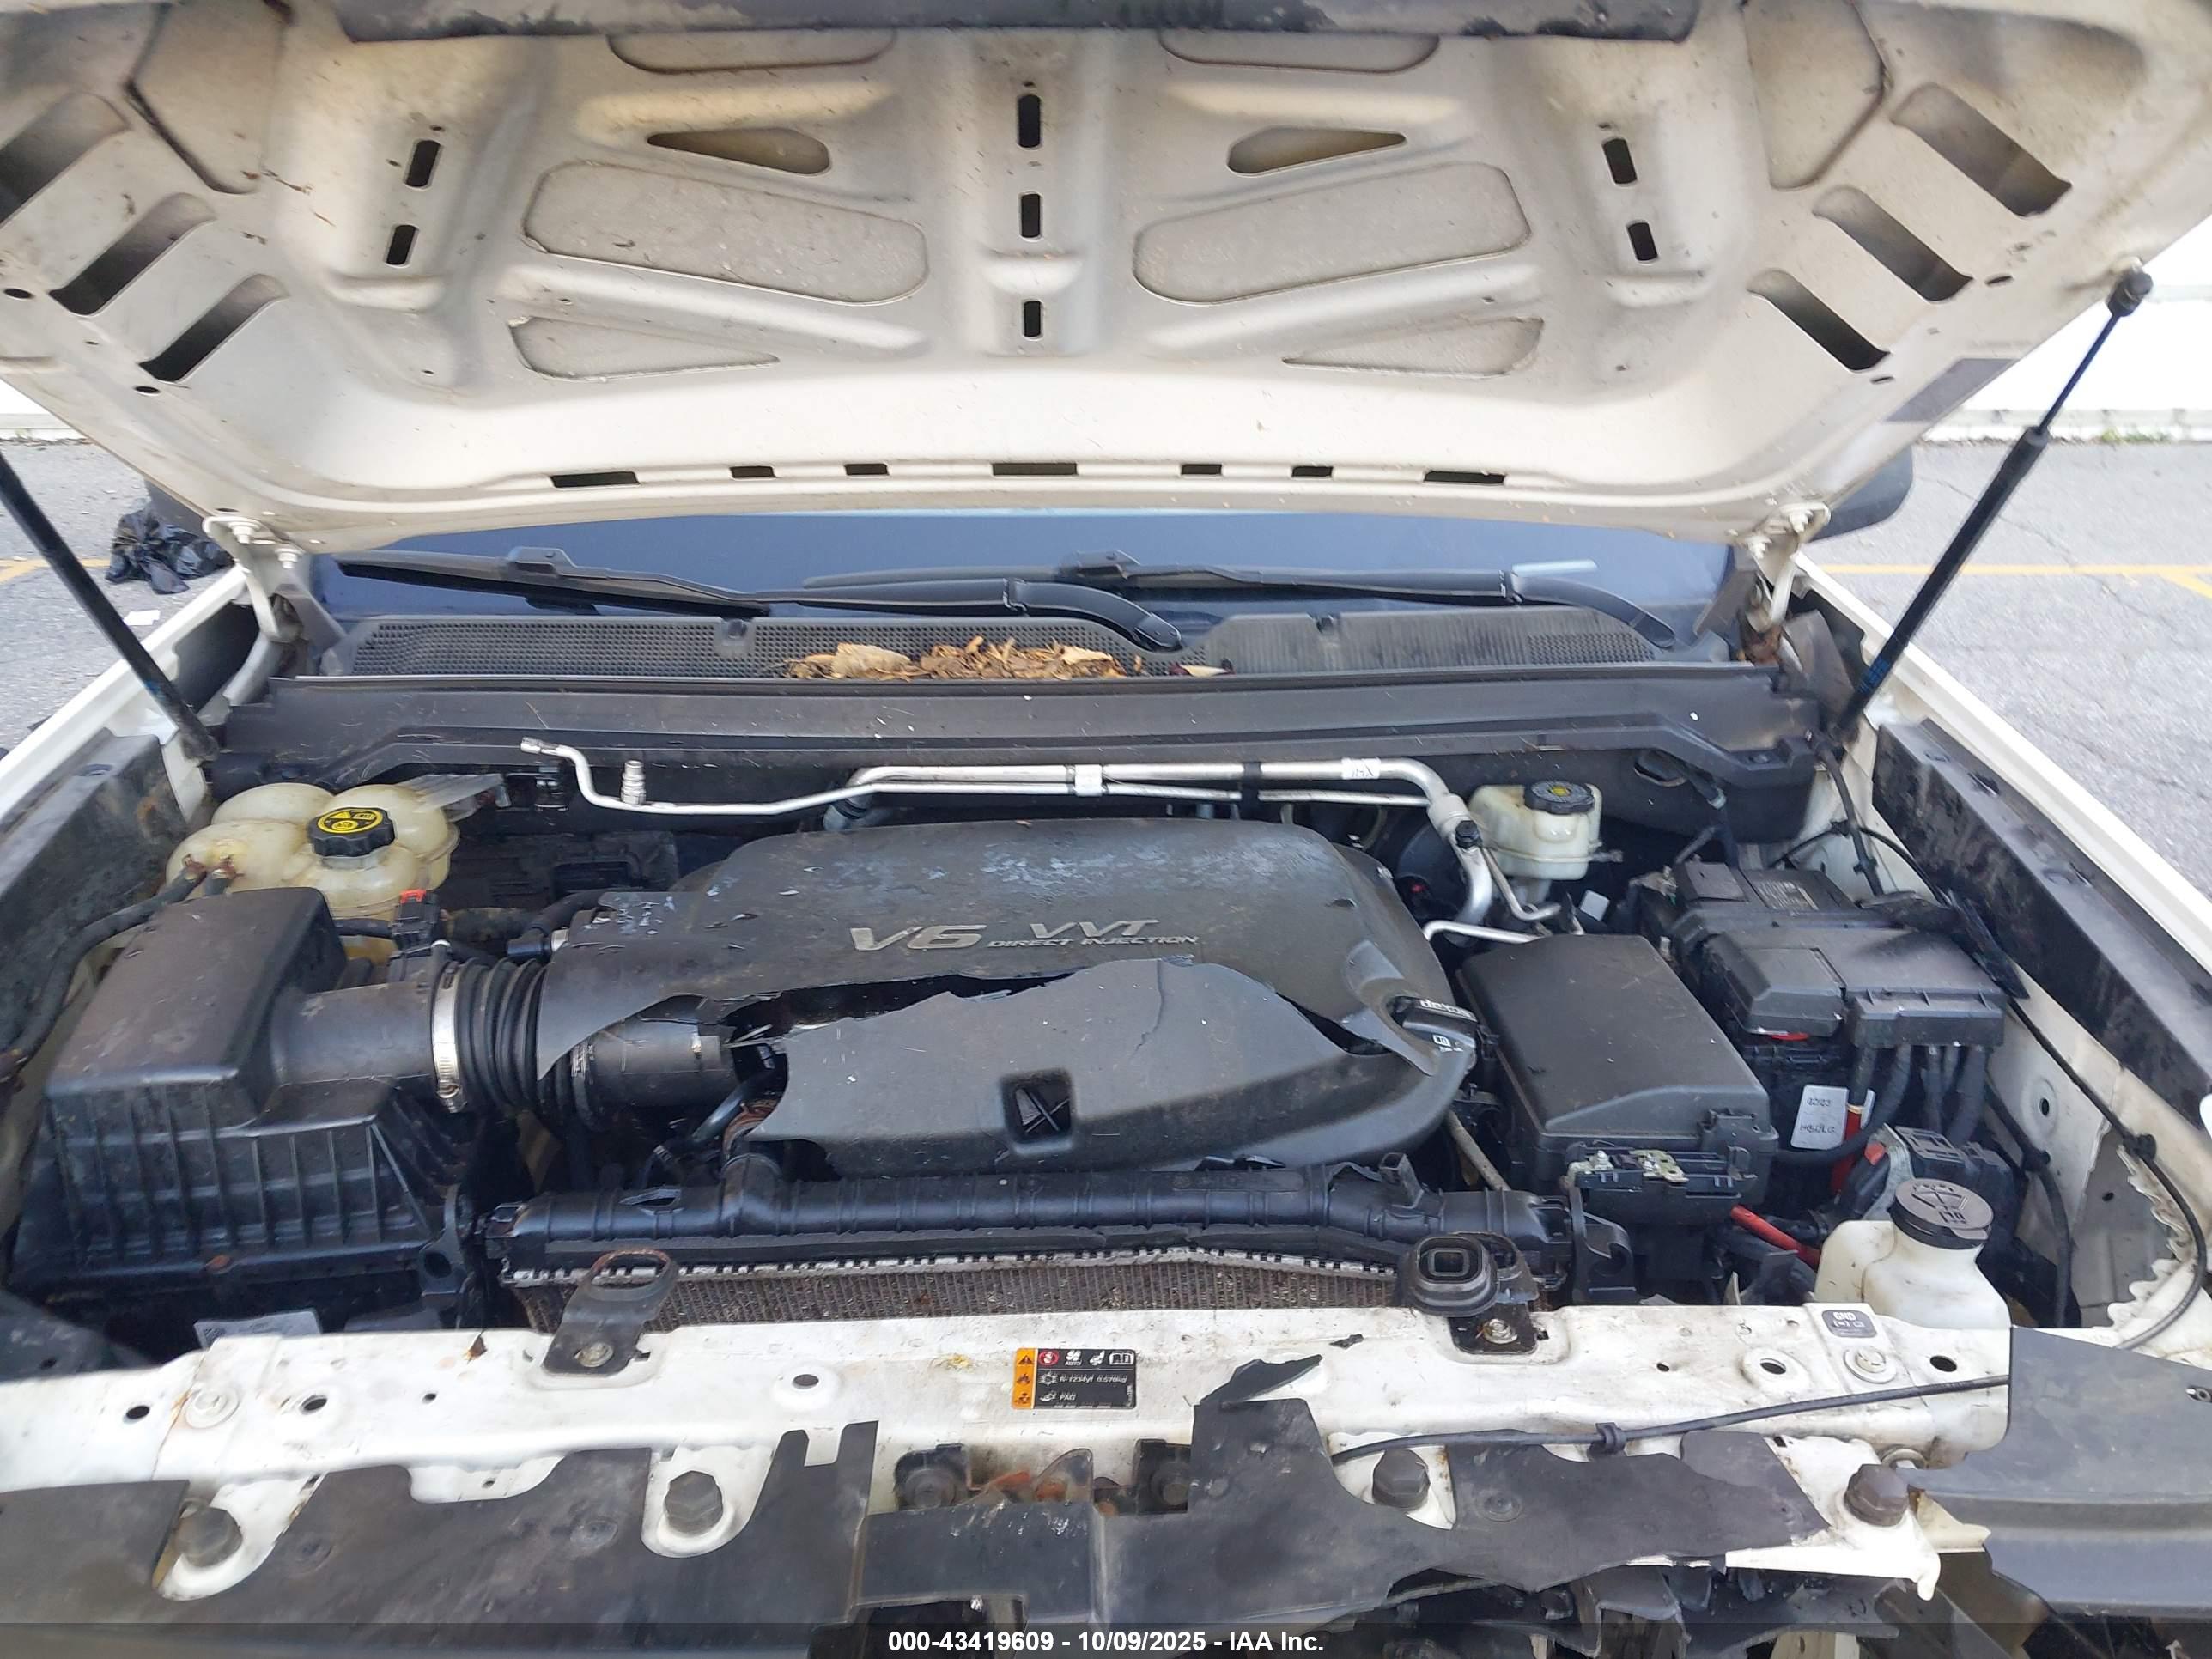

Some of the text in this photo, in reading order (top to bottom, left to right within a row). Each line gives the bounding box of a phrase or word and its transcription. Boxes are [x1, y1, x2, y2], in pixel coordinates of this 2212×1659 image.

[1030, 919, 1160, 939] VVT
[850, 924, 988, 951] V6
[988, 935, 1200, 948] DIRECT INJECTION
[1832, 1311, 1856, 1321] GND
[1060, 1392, 1076, 1401] PAG
